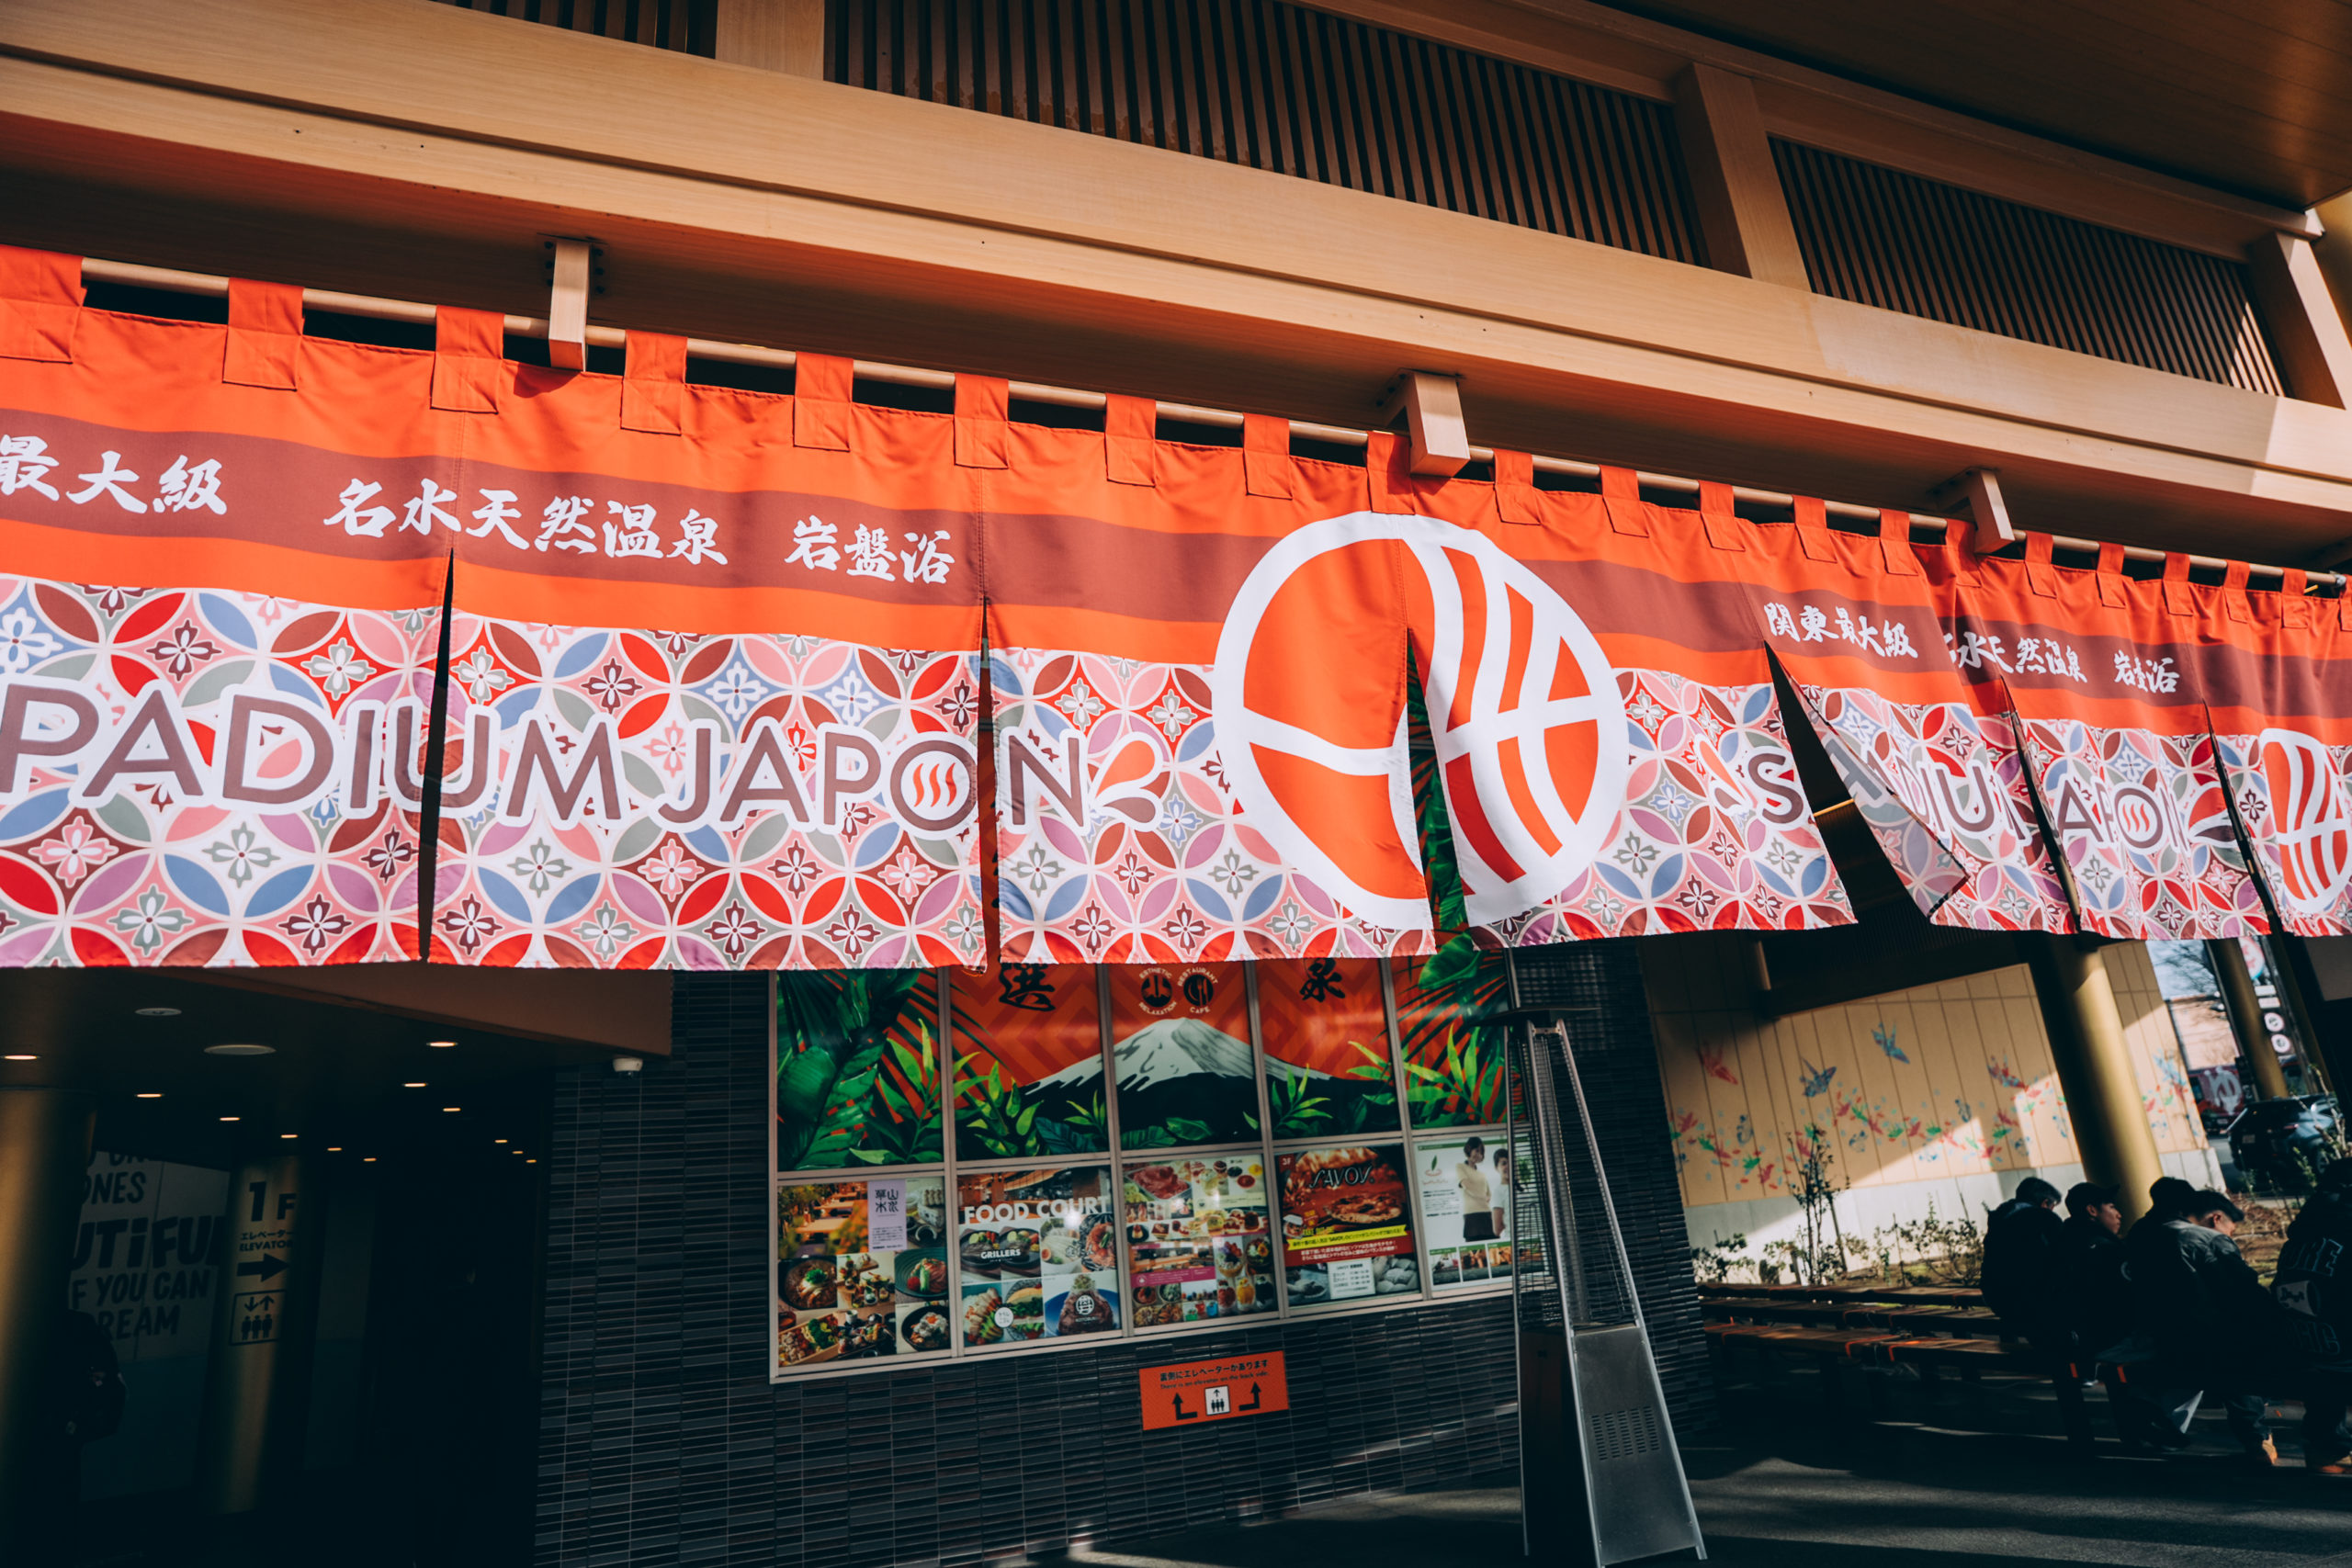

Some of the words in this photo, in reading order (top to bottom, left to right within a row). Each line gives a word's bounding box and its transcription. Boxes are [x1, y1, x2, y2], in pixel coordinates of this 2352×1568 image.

[0, 434, 228, 514] 最大級
[322, 478, 729, 566] 名水天然温泉
[784, 514, 956, 585] 岩盤浴
[1763, 602, 1919, 659] 関東最大級
[0, 683, 622, 823] PADIUM
[657, 725, 1085, 832] JAPON
[1177, 966, 1219, 987] RESTAURANT
[1138, 1000, 1178, 1016] RELAXATION
[1189, 1006, 1211, 1014] CAFE
[964, 1202, 1030, 1224] FOOD
[1035, 1196, 1110, 1219] COURT
[980, 1248, 1022, 1259] GRILLERS
[96, 1273, 148, 1306] YOU
[153, 1269, 210, 1301] CAN
